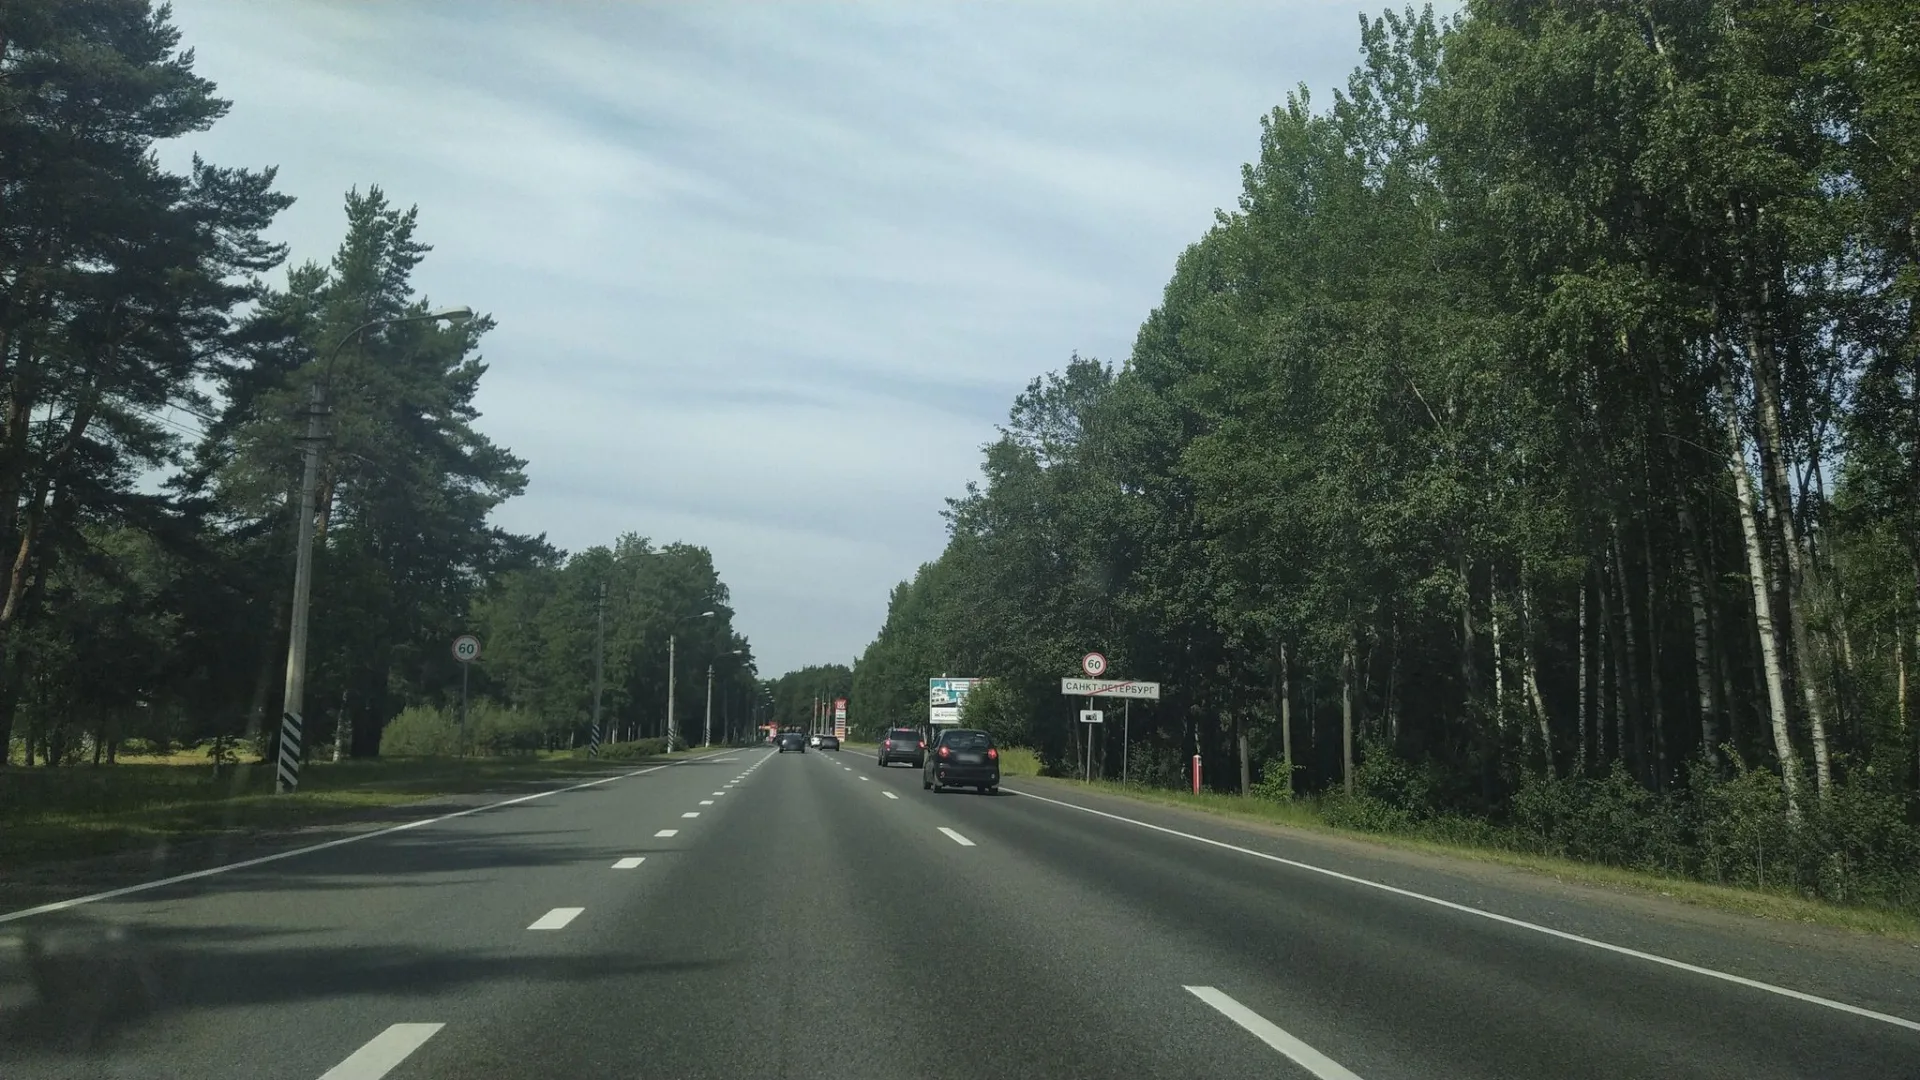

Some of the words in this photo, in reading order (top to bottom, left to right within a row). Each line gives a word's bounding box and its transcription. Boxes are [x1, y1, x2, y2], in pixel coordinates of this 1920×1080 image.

[458, 643, 474, 654] 60
[1088, 659, 1101, 670] 60
[1066, 682, 1155, 694] САНКТ-ПЕТЕРБУРГ
